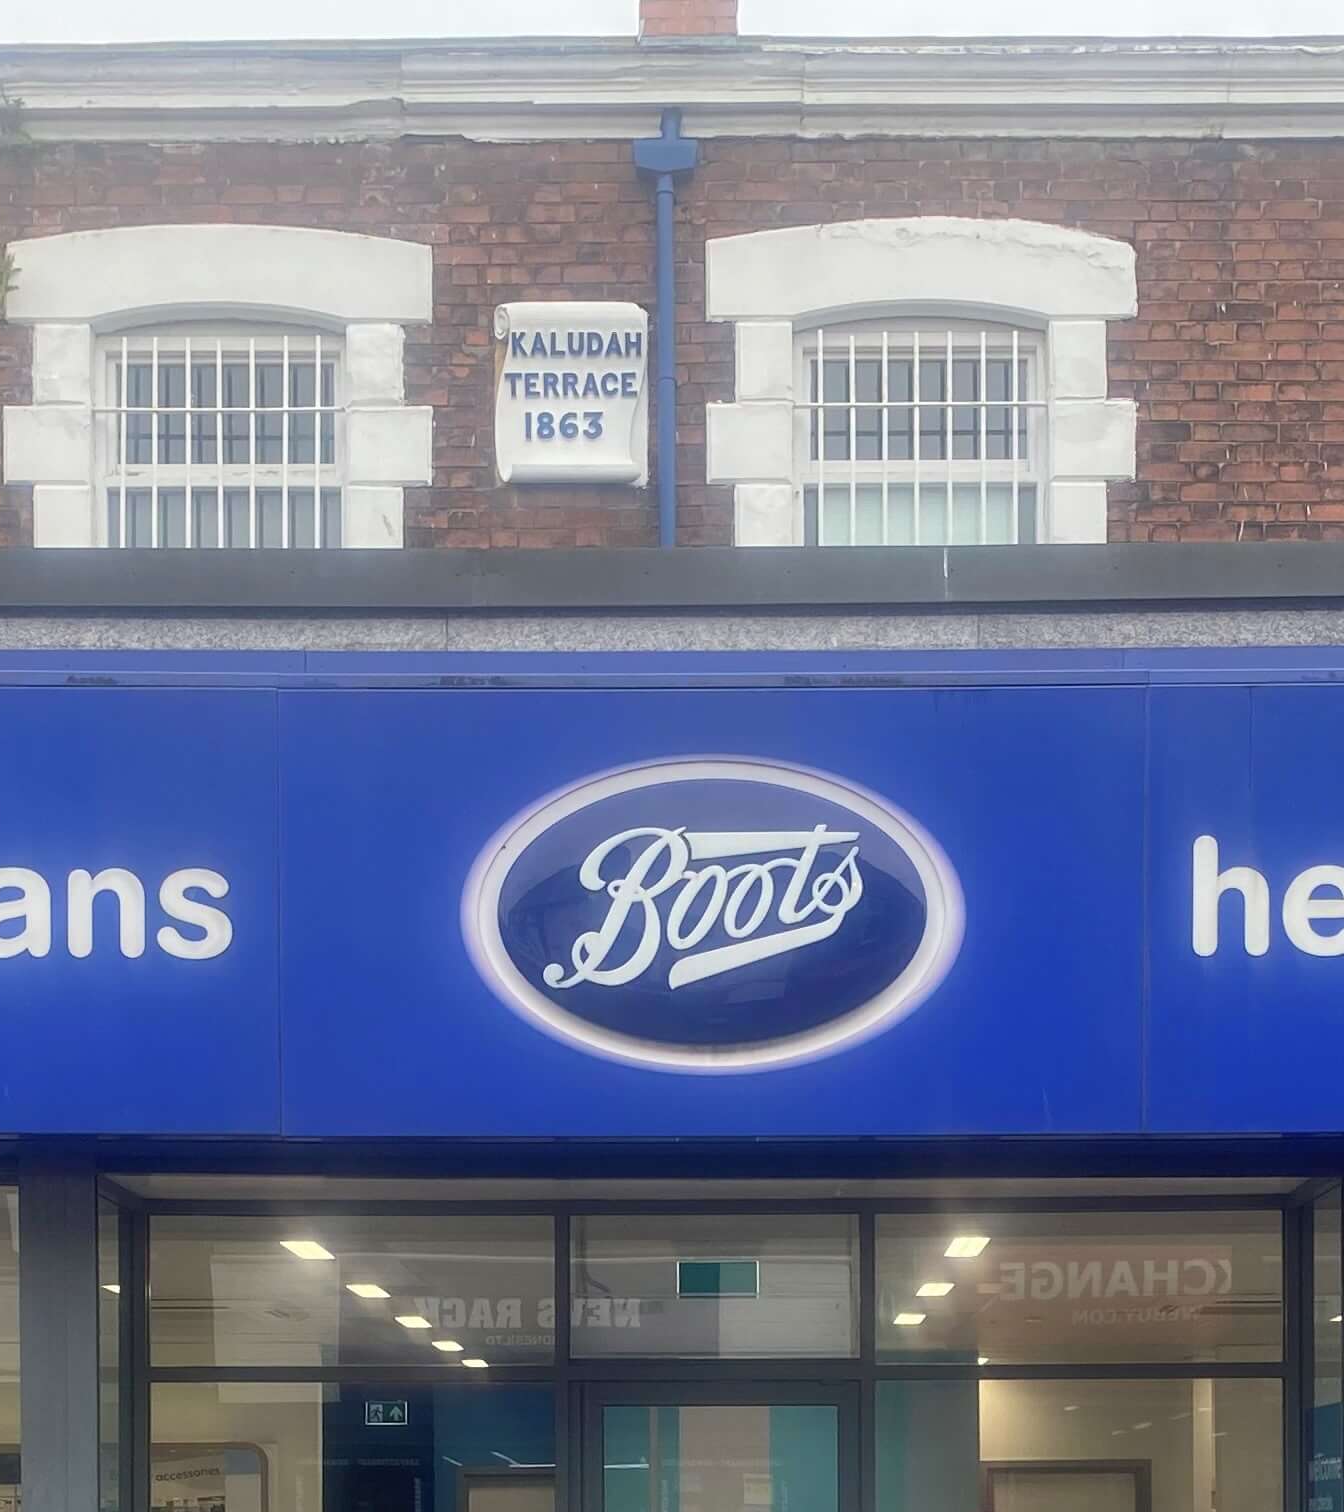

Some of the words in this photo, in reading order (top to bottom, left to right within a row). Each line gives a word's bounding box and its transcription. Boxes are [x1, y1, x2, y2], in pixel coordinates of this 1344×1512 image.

[511, 331, 642, 358] KALUDAH
[504, 372, 638, 399] TERRACE
[524, 411, 604, 441] 1863
[543, 823, 863, 990] Boots
